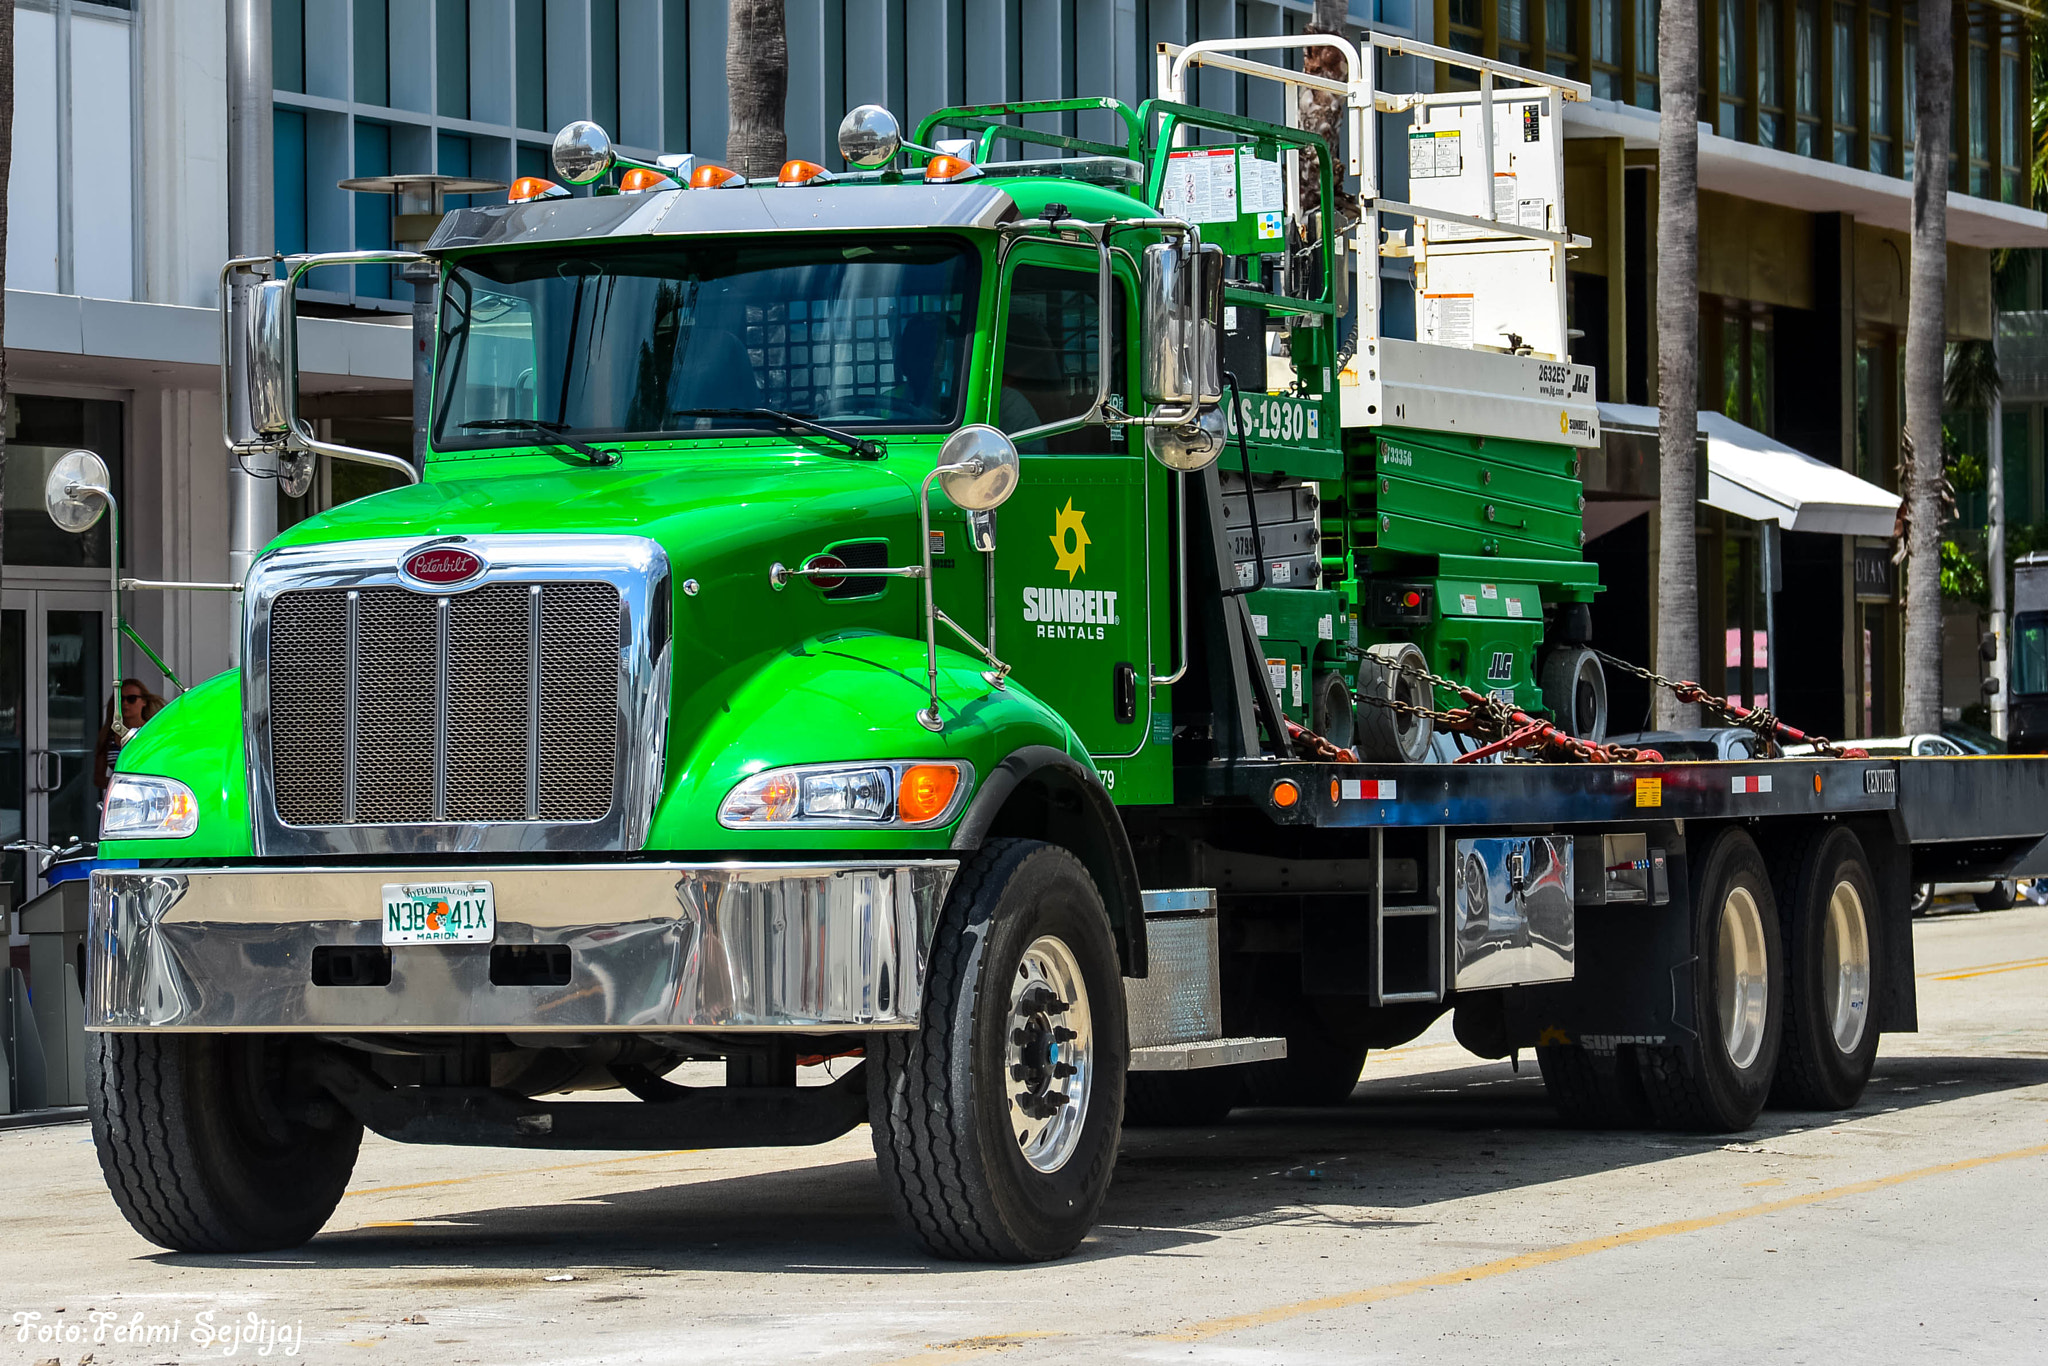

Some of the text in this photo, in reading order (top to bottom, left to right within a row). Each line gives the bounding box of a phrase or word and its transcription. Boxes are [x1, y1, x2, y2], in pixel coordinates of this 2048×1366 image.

[1538, 364, 1566, 384] 2632ES
[1572, 373, 1590, 394] JLG
[1539, 385, 1564, 398] www.jlg.com
[1227, 398, 1304, 441] GS-1930
[1569, 418, 1588, 431] SUNBELT
[414, 555, 473, 575] Peterbilt
[1022, 586, 1118, 625] SUNBELT
[1036, 624, 1105, 640] RENTALS
[1487, 652, 1514, 680] JLG
[1865, 769, 1896, 794] CENTURY
[388, 899, 487, 931] N38 41X
[416, 932, 459, 940] MARION
